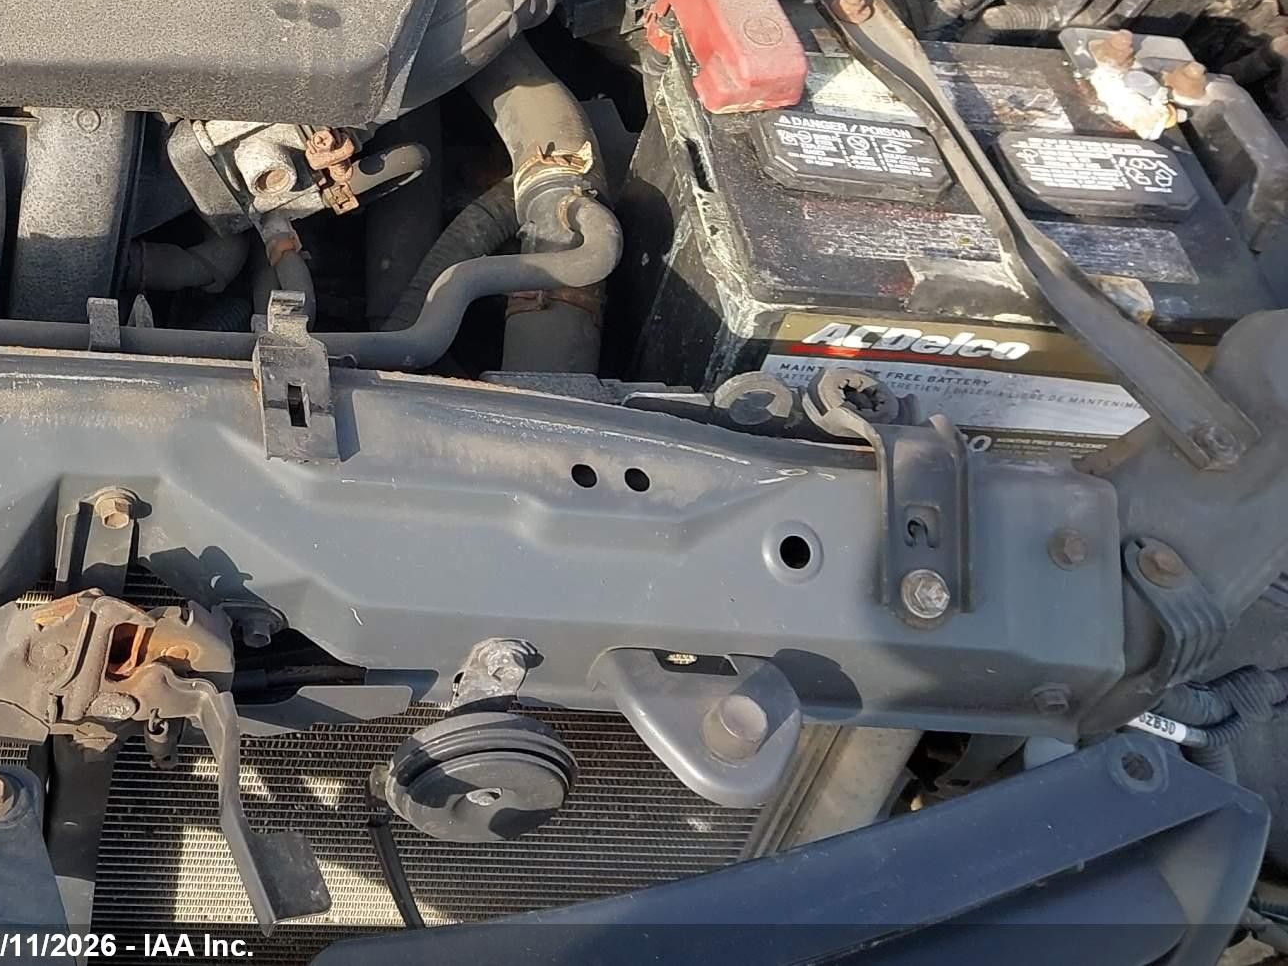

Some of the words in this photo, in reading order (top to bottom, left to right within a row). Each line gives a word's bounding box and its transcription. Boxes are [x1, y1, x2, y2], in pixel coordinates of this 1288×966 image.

[792, 116, 849, 132] DANGER
[861, 125, 912, 139] POISON
[802, 321, 1031, 360] ACDelco
[886, 371, 923, 382] FREE
[927, 376, 992, 386] BATTERY
[1048, 395, 1065, 403] DE
